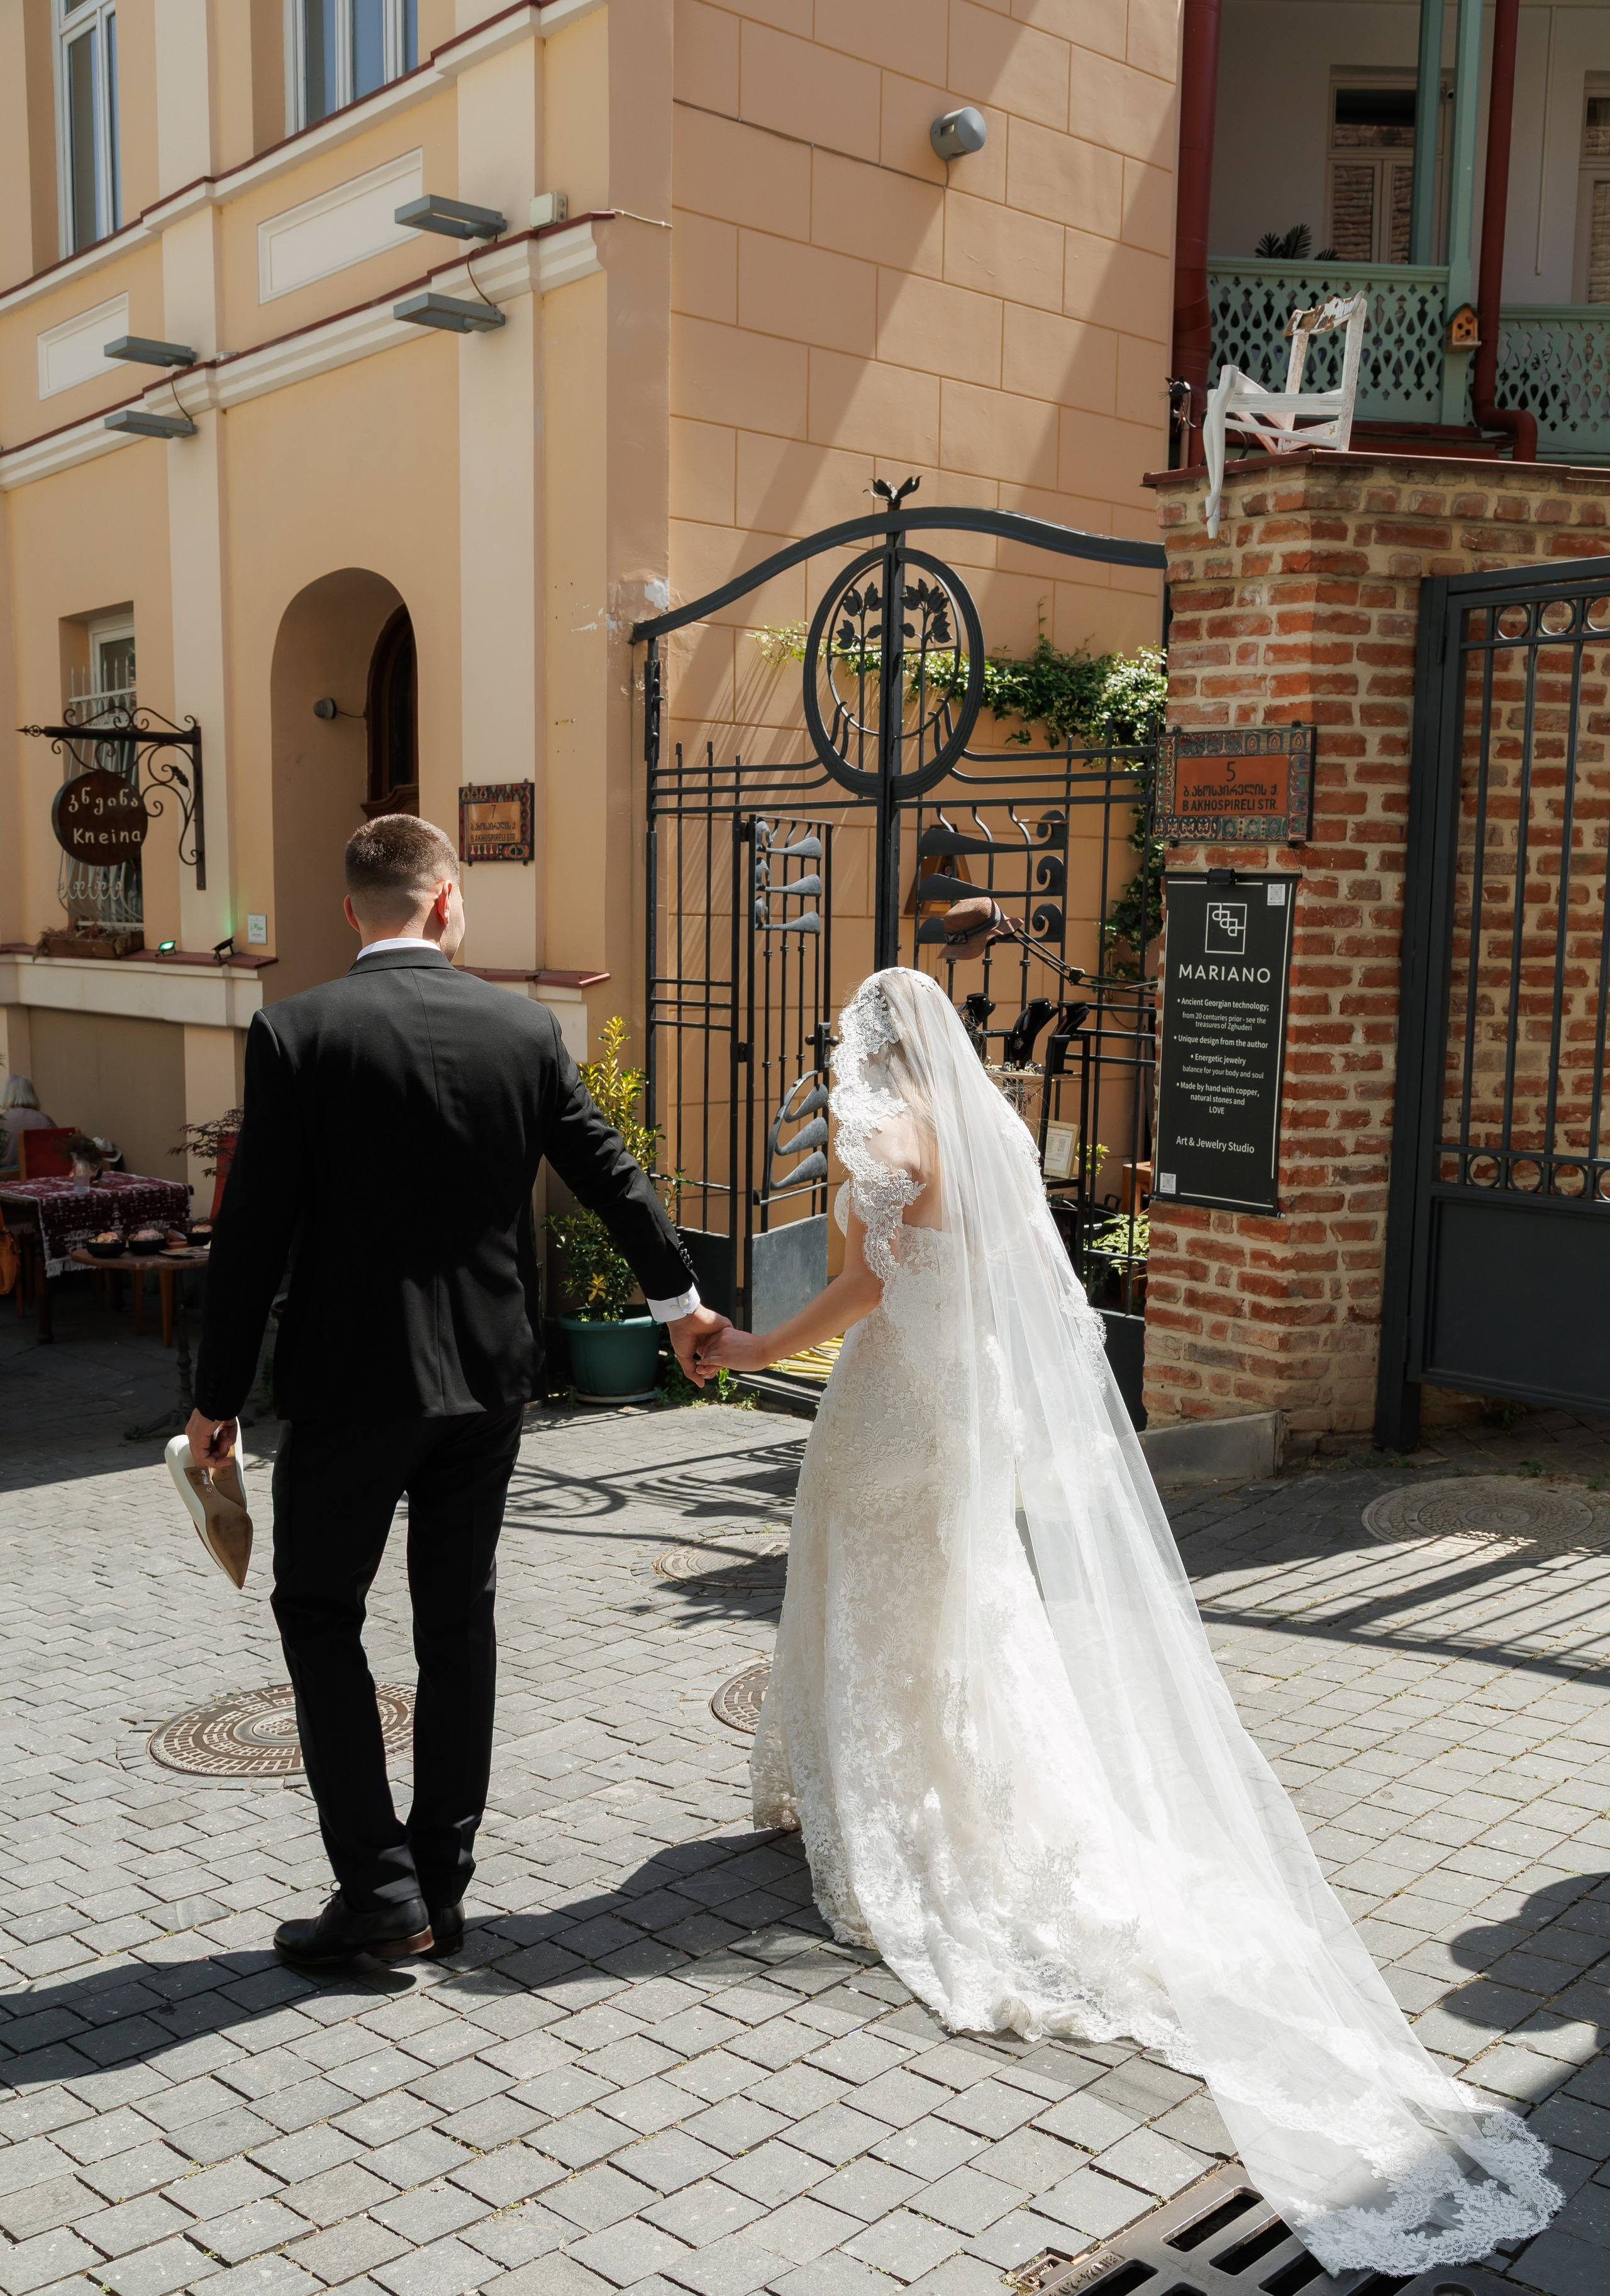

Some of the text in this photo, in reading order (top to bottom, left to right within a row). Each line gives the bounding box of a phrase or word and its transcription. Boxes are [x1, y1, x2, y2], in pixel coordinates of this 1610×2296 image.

[1226, 761, 1236, 782] 5
[69, 787, 138, 815] კნეინა
[1258, 799, 1278, 810] STR.
[491, 804, 496, 818] 7
[74, 828, 141, 844] Kneina
[1179, 964, 1270, 984] MARIANO
[1181, 997, 1269, 1011] Ancient Georgian technology;
[1182, 1011, 1194, 1019] from
[1228, 1023, 1252, 1031] Zghuderi
[1178, 1034, 1198, 1044] Unique
[1199, 1036, 1219, 1046] design
[1220, 1038, 1235, 1046] from
[1236, 1039, 1246, 1047] the
[1195, 1054, 1246, 1066] Energetic jewelry
[1226, 1069, 1239, 1078] body
[1197, 1083, 1204, 1092] by
[1206, 1084, 1220, 1092] hand
[1221, 1085, 1235, 1094] with
[1236, 1087, 1259, 1097] copper,
[1191, 1094, 1211, 1102] natural
[1213, 1095, 1232, 1104] stones
[1209, 1106, 1224, 1114] LOVE
[1176, 1136, 1255, 1153] Art & Jewelry Studio
